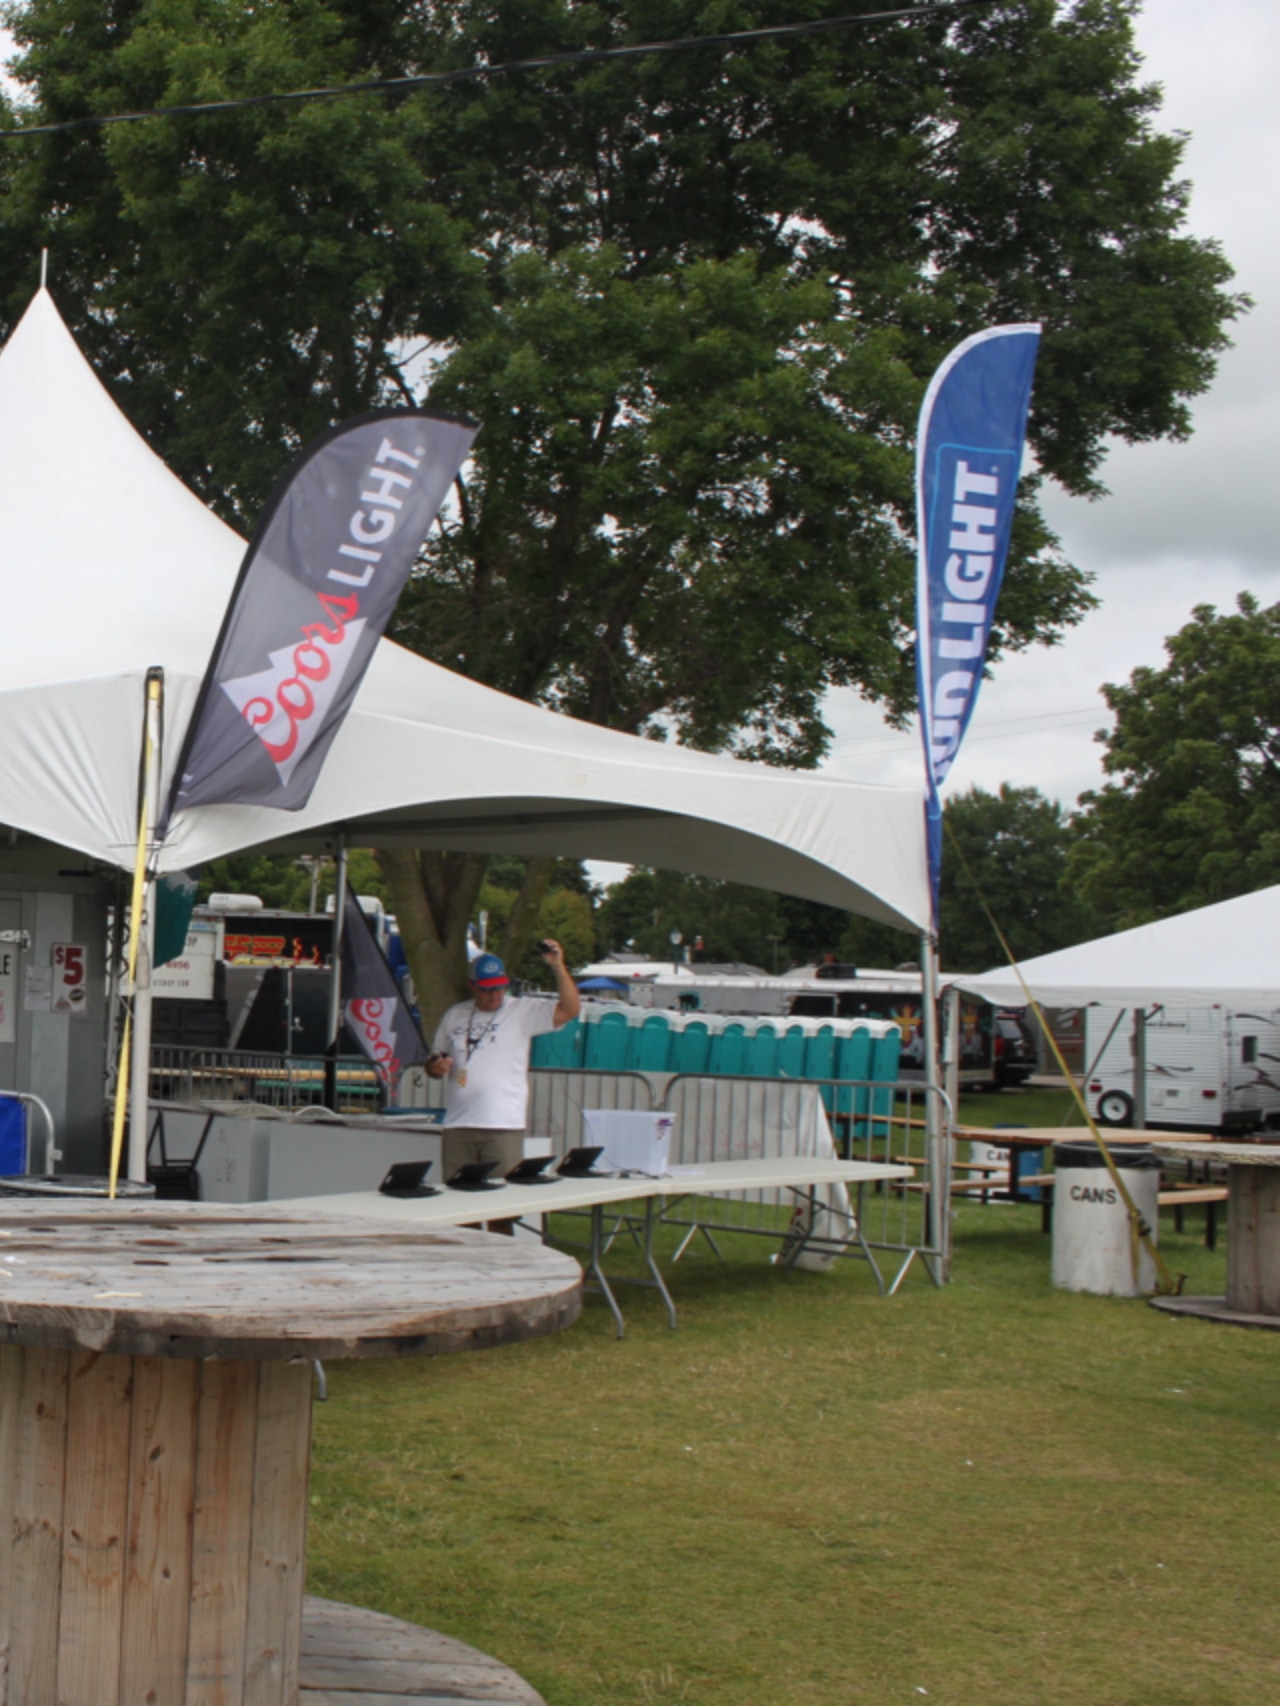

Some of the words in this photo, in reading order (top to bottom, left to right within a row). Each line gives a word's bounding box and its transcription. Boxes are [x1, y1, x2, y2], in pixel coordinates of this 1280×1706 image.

[241, 591, 360, 765] Coors
[326, 436, 422, 588] LIGHT
[938, 459, 1000, 661] LIGHT
[55, 946, 84, 987] $5
[1070, 1185, 1117, 1205] CANS
